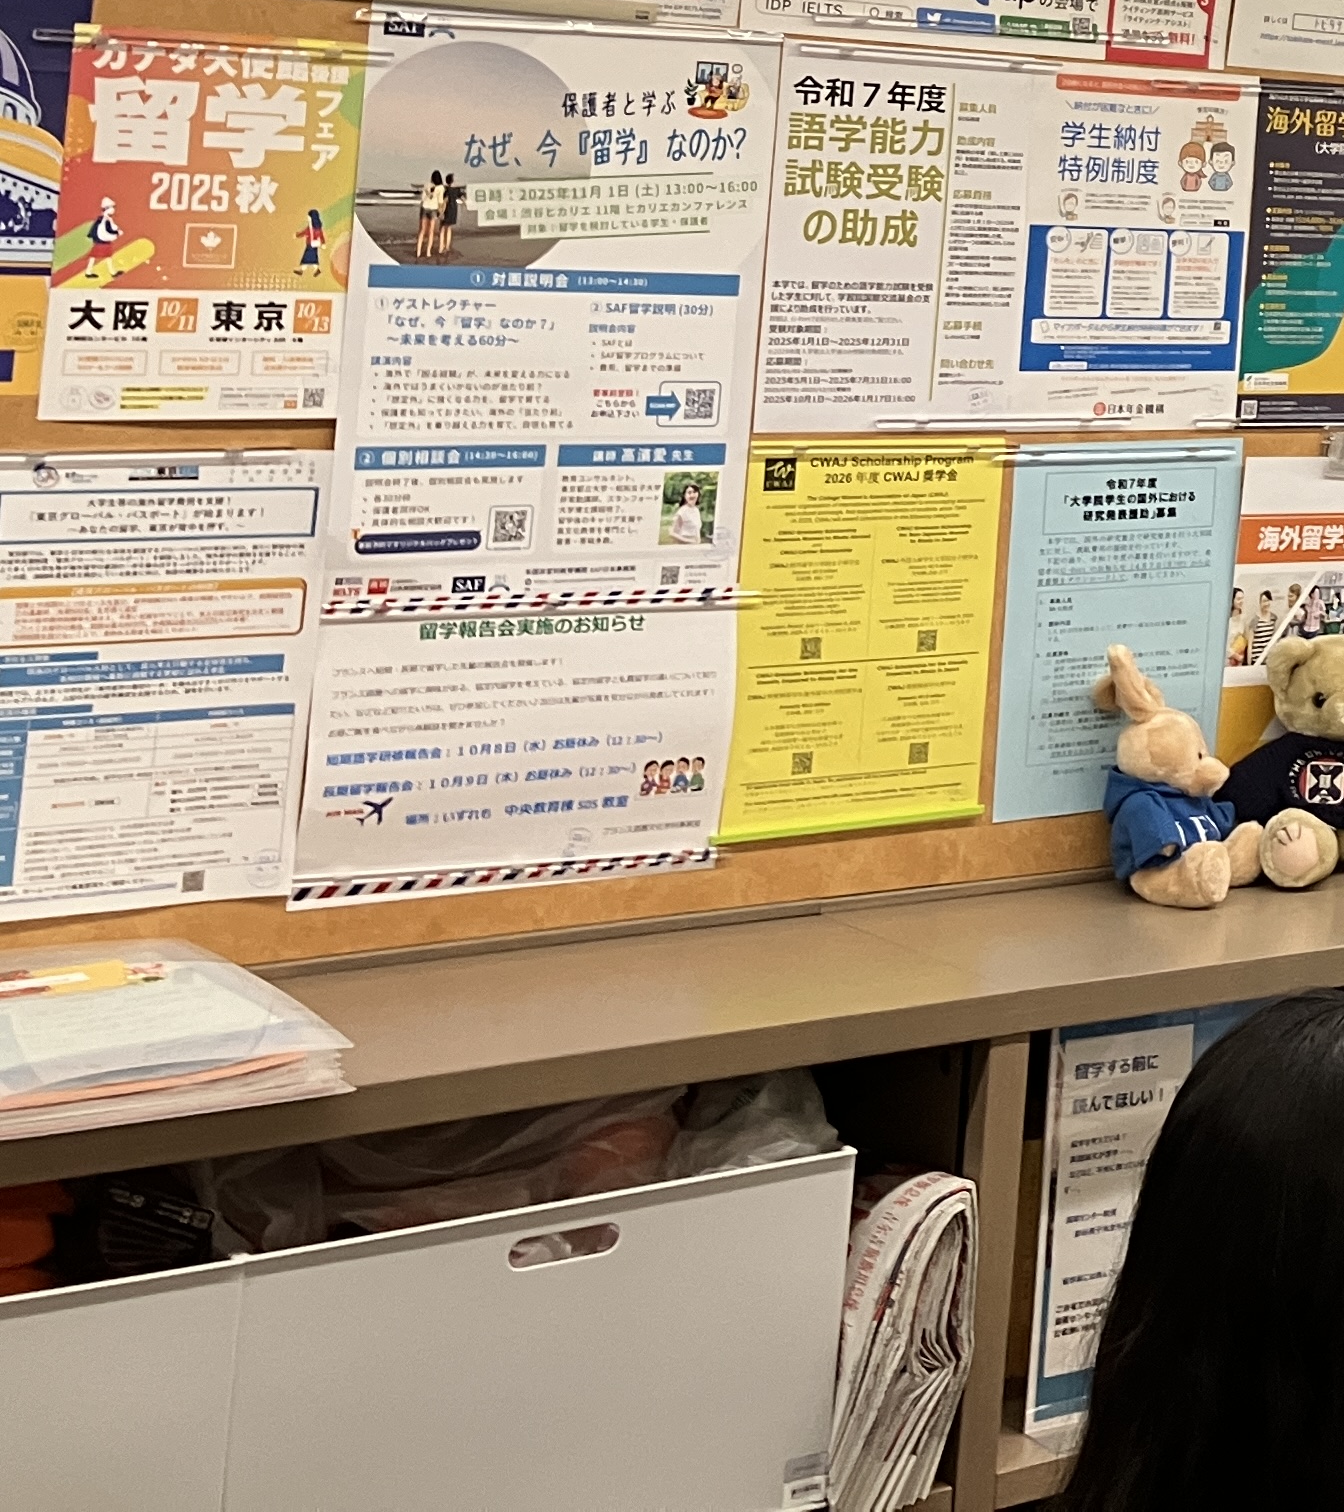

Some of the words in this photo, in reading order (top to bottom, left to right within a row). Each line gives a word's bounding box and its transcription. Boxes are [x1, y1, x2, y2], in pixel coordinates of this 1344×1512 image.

[801, 2, 843, 18] IELTS
[562, 91, 677, 119] 保護者と学ぶ
[793, 75, 947, 114] 令和7年度
[89, 75, 307, 170] 留学
[787, 111, 945, 156] 語学能力
[1061, 122, 1161, 152] 学生納付
[784, 158, 944, 203] 試験受験
[1058, 156, 1160, 185] 特例制度
[804, 208, 919, 248] の助成
[68, 299, 149, 331] 大阪
[211, 301, 288, 332] 東京
[809, 455, 847, 469] CWAJ
[851, 455, 922, 469] Scholarship
[925, 454, 974, 468] Program
[824, 473, 853, 484] 2026
[883, 471, 920, 484] CWAJ
[455, 578, 484, 593] SAF
[419, 616, 645, 640] 留学報告会実施のお知らせ
[1075, 1054, 1159, 1080] 留学する前に
